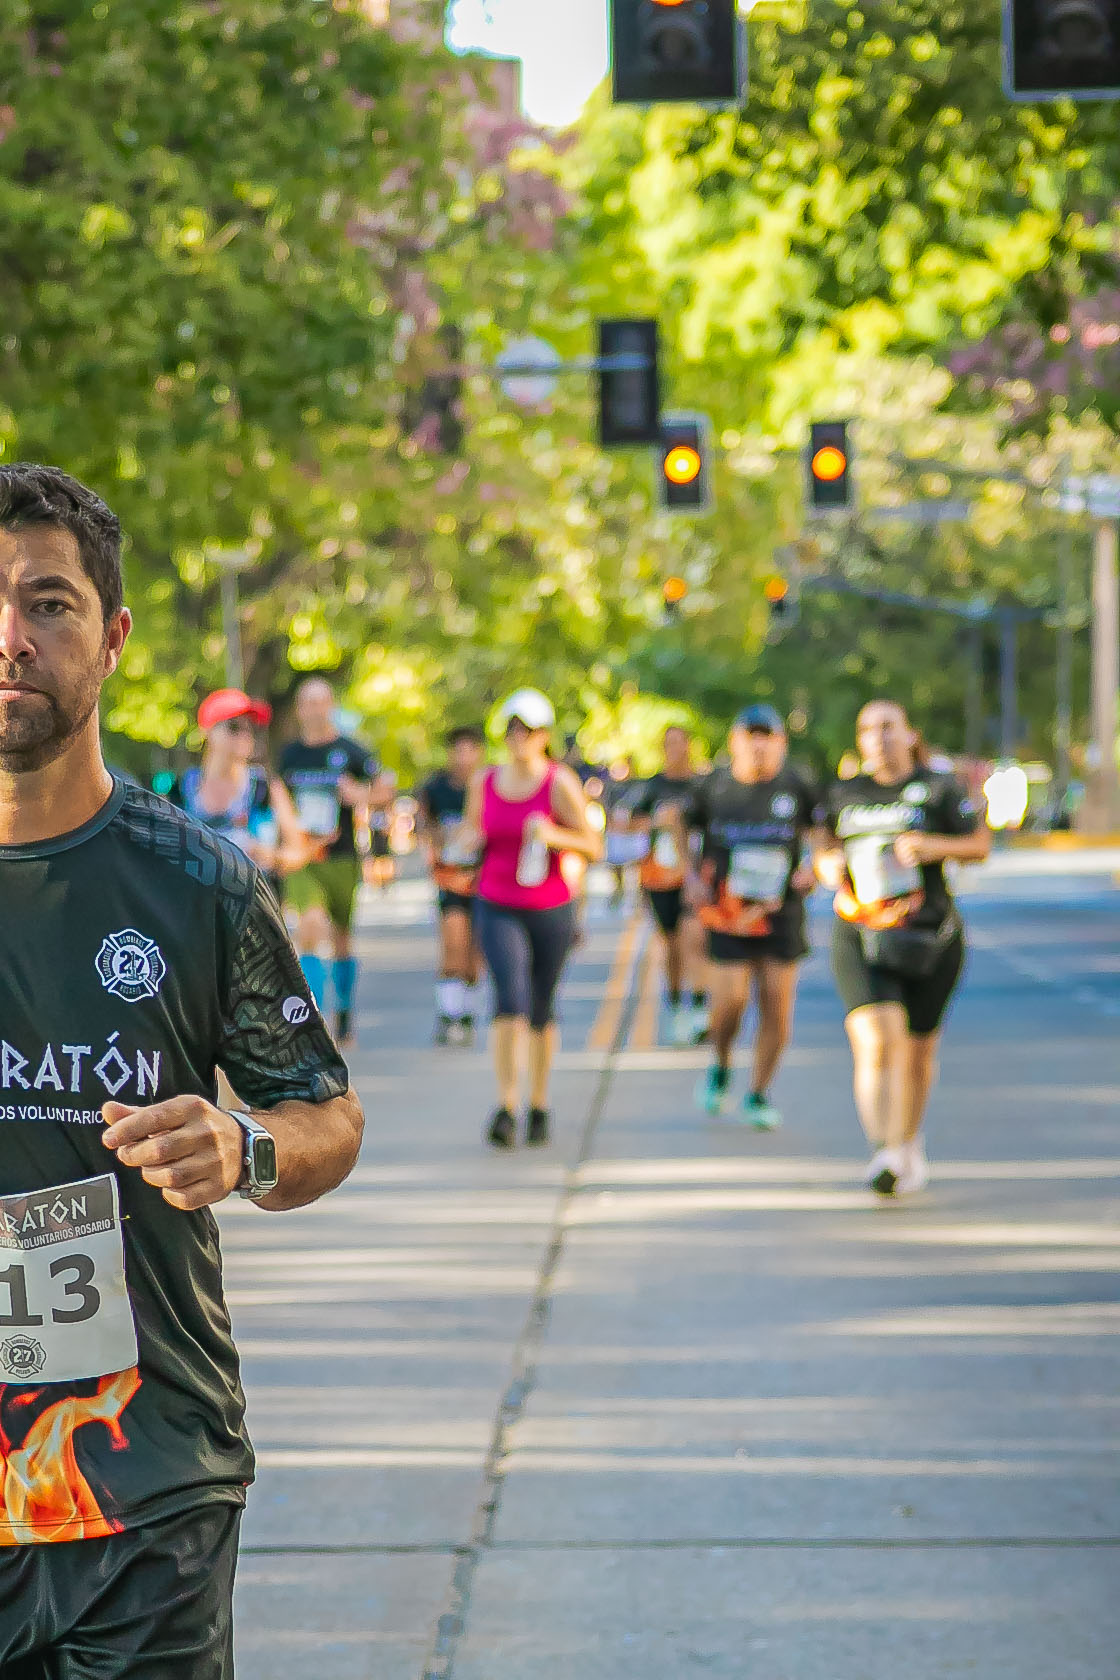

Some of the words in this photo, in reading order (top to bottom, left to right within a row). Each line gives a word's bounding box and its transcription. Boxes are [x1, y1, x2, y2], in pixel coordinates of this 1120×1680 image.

[119, 949, 145, 974] 27
[18, 1105, 103, 1125] VOLUNTARIO
[18, 1227, 74, 1249] VOLUNTARIOS
[75, 1218, 112, 1237] ROSARIO
[12, 1348, 32, 1363] 27
